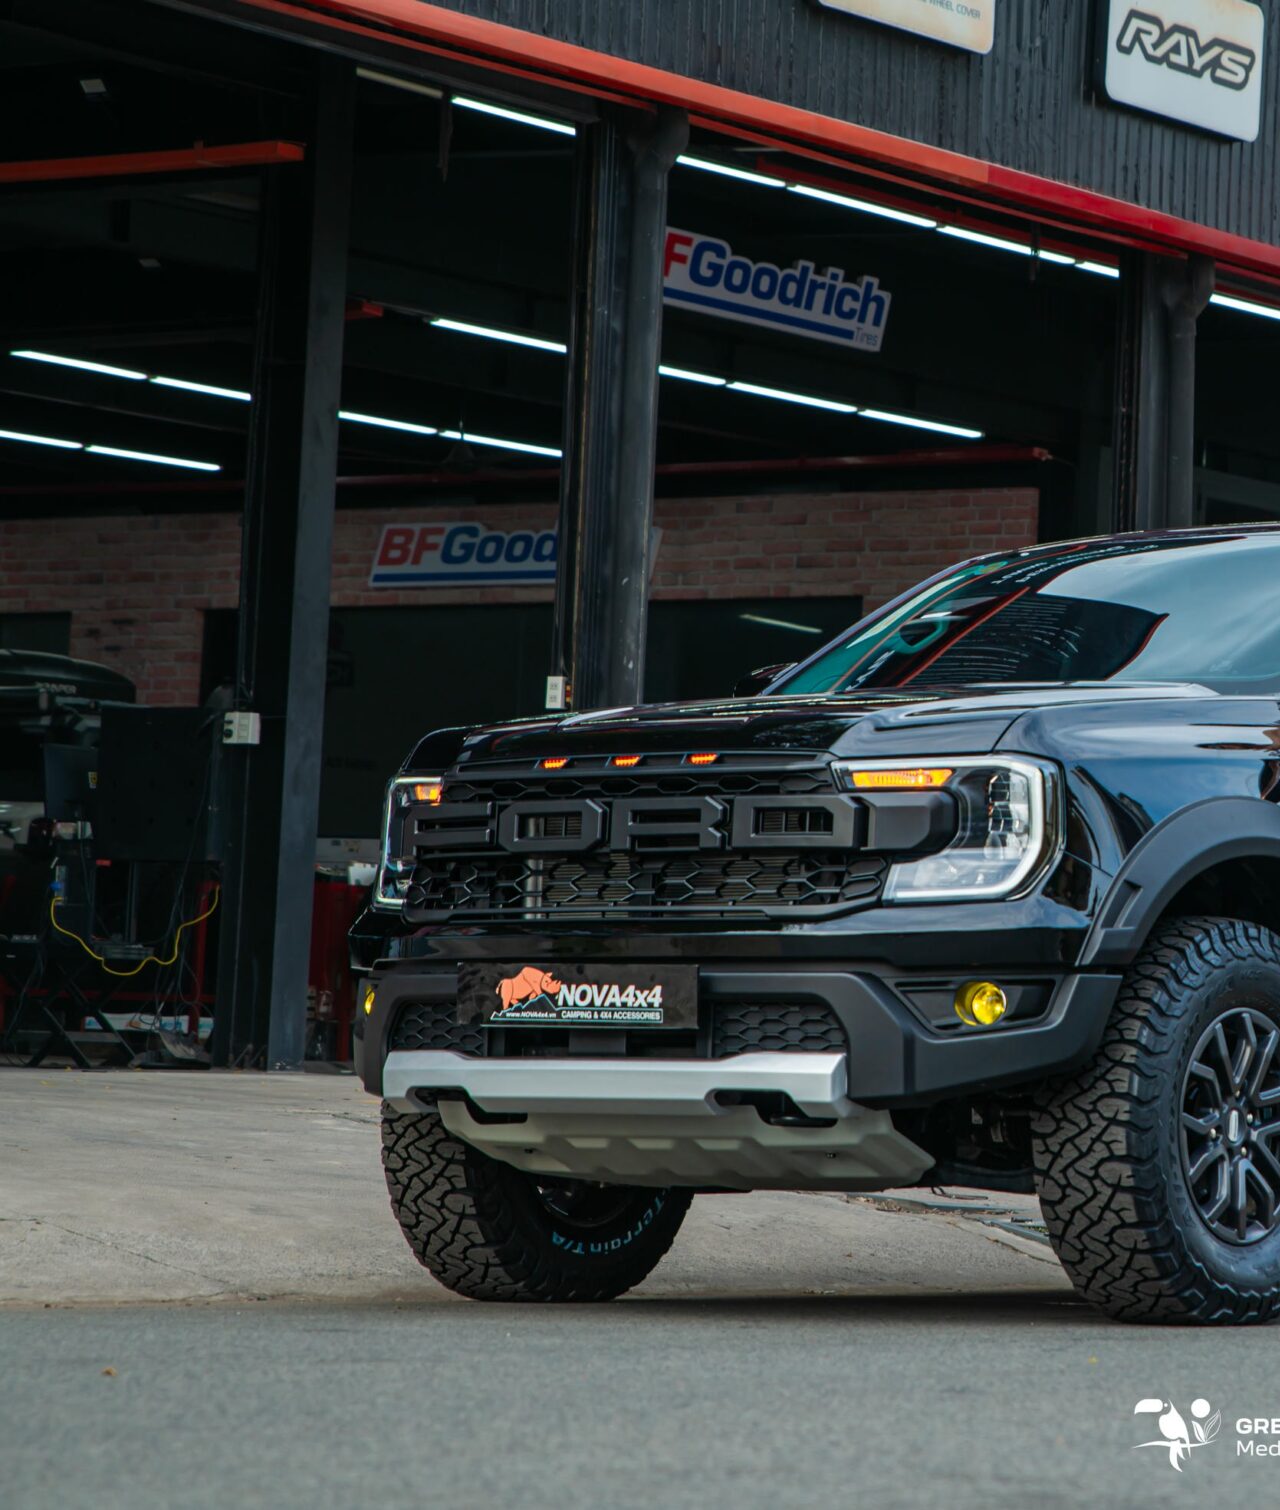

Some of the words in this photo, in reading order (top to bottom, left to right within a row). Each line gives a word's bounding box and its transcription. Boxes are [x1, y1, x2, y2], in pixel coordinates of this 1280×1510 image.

[956, 4, 981, 19] COVER
[1117, 9, 1256, 91] RAYS
[663, 231, 886, 328] FGoodrich
[855, 326, 878, 346] Tires
[377, 525, 558, 567] BFGood
[402, 796, 867, 857] FORD
[557, 984, 663, 1008] NOVA4x4
[561, 1010, 592, 1019] CAMPING
[593, 1011, 598, 1019] &
[600, 1011, 612, 1019] 4X4
[613, 1011, 661, 1020] ACCESSORIES
